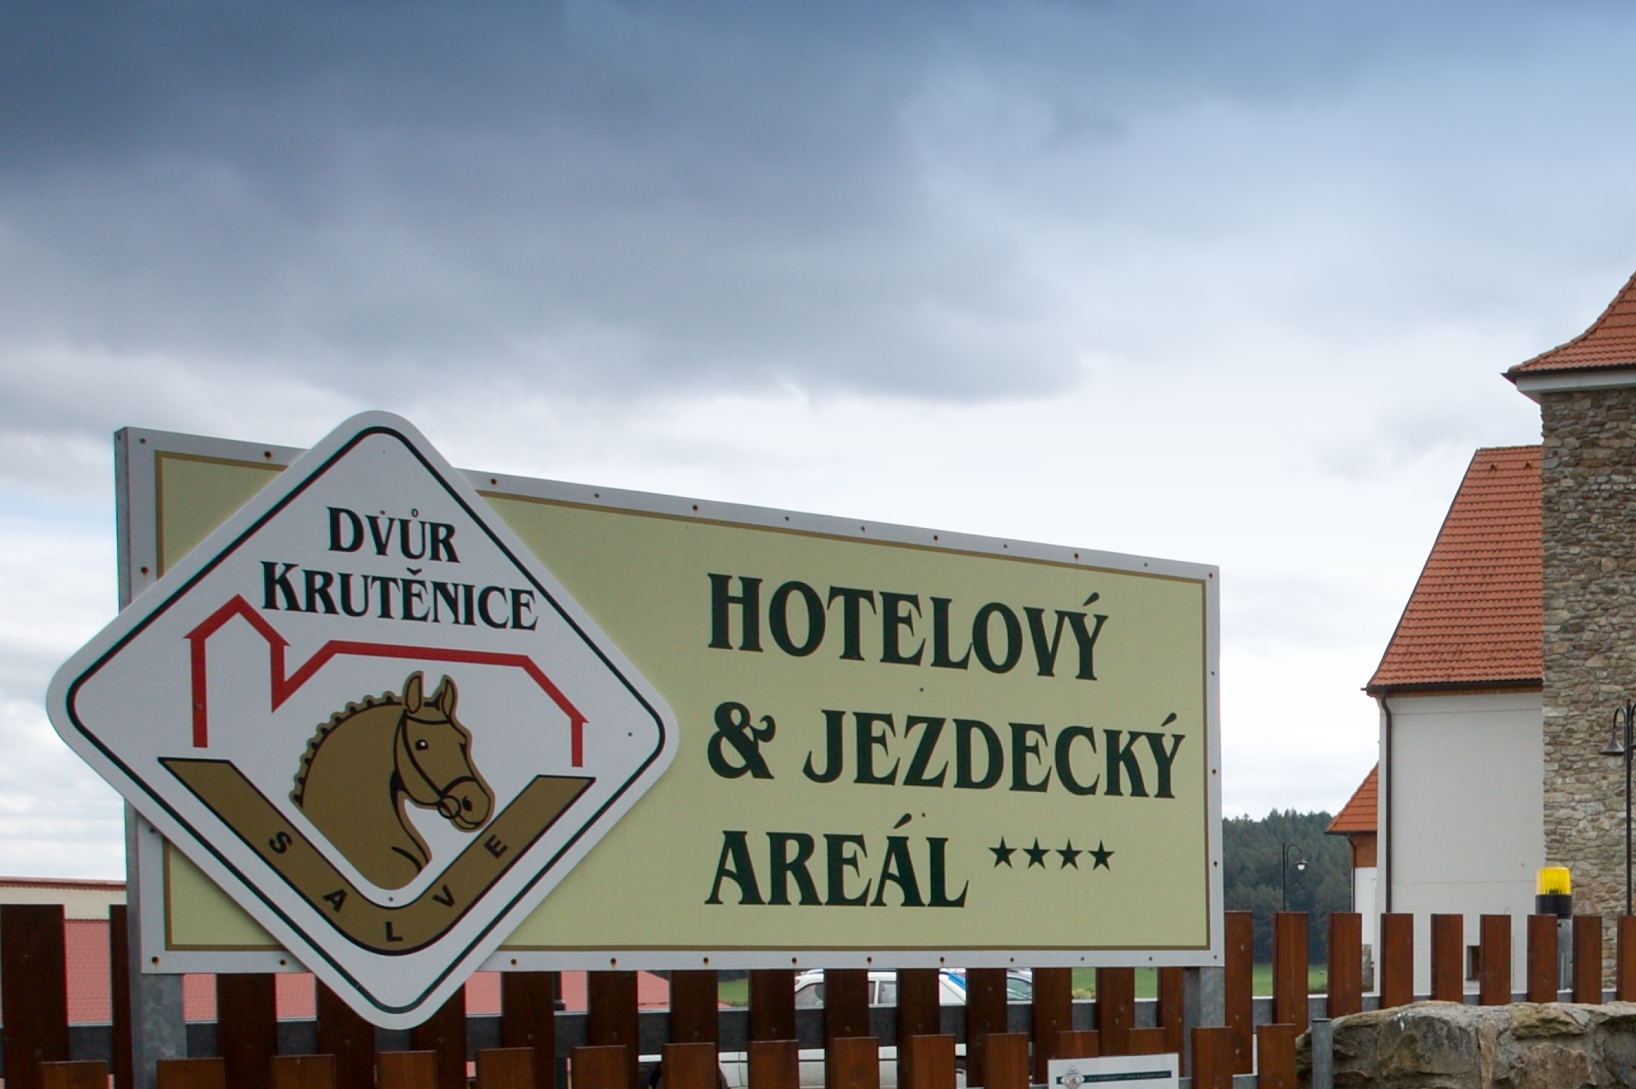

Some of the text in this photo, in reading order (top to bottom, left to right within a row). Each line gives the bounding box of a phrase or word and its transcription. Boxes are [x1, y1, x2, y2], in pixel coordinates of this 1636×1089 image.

[326, 506, 461, 563] DVŮR
[260, 560, 540, 632] KRUTĚNICE
[707, 572, 1109, 681] HOTELOVÝ
[707, 701, 1186, 799] & JEZDECKÝ
[268, 830, 509, 943] SALVE
[704, 812, 970, 908] AREÁL
